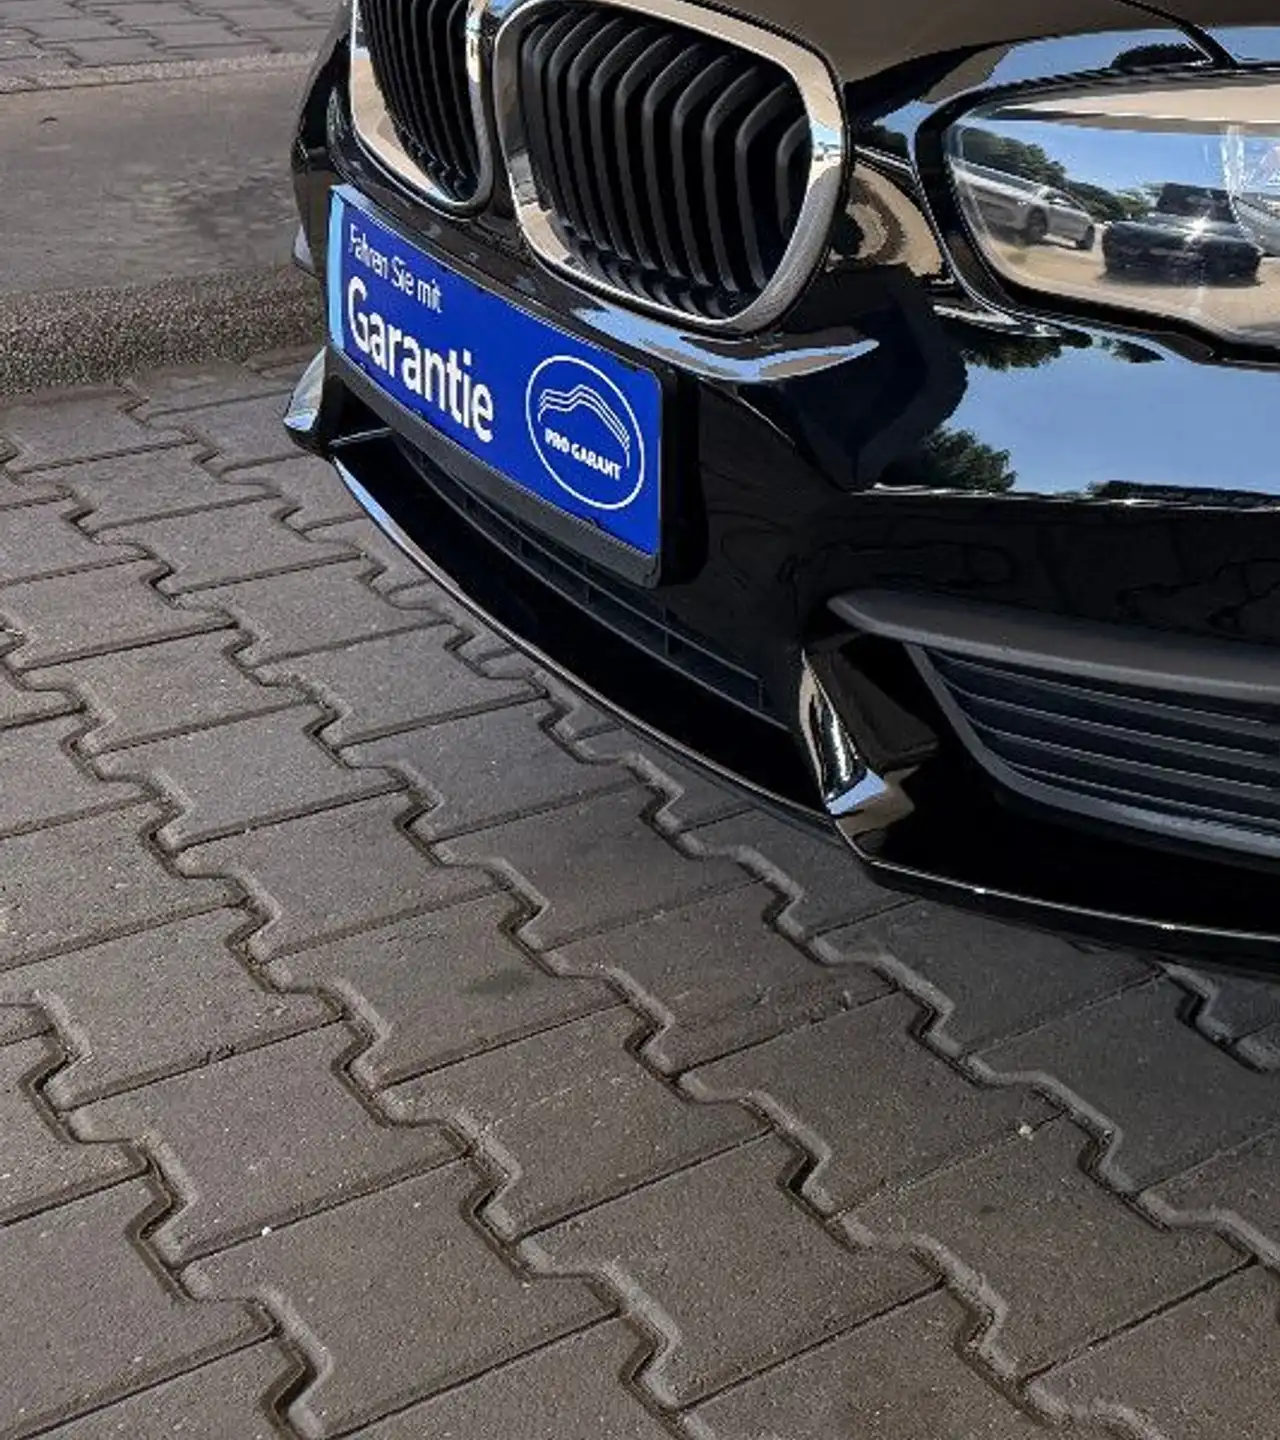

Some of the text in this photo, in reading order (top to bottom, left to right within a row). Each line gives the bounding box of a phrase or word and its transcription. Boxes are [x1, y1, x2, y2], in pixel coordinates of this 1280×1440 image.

[348, 222, 443, 314] Fahren Sie mit
[346, 274, 494, 444] Garantie
[544, 426, 623, 480] PRO GARANT
